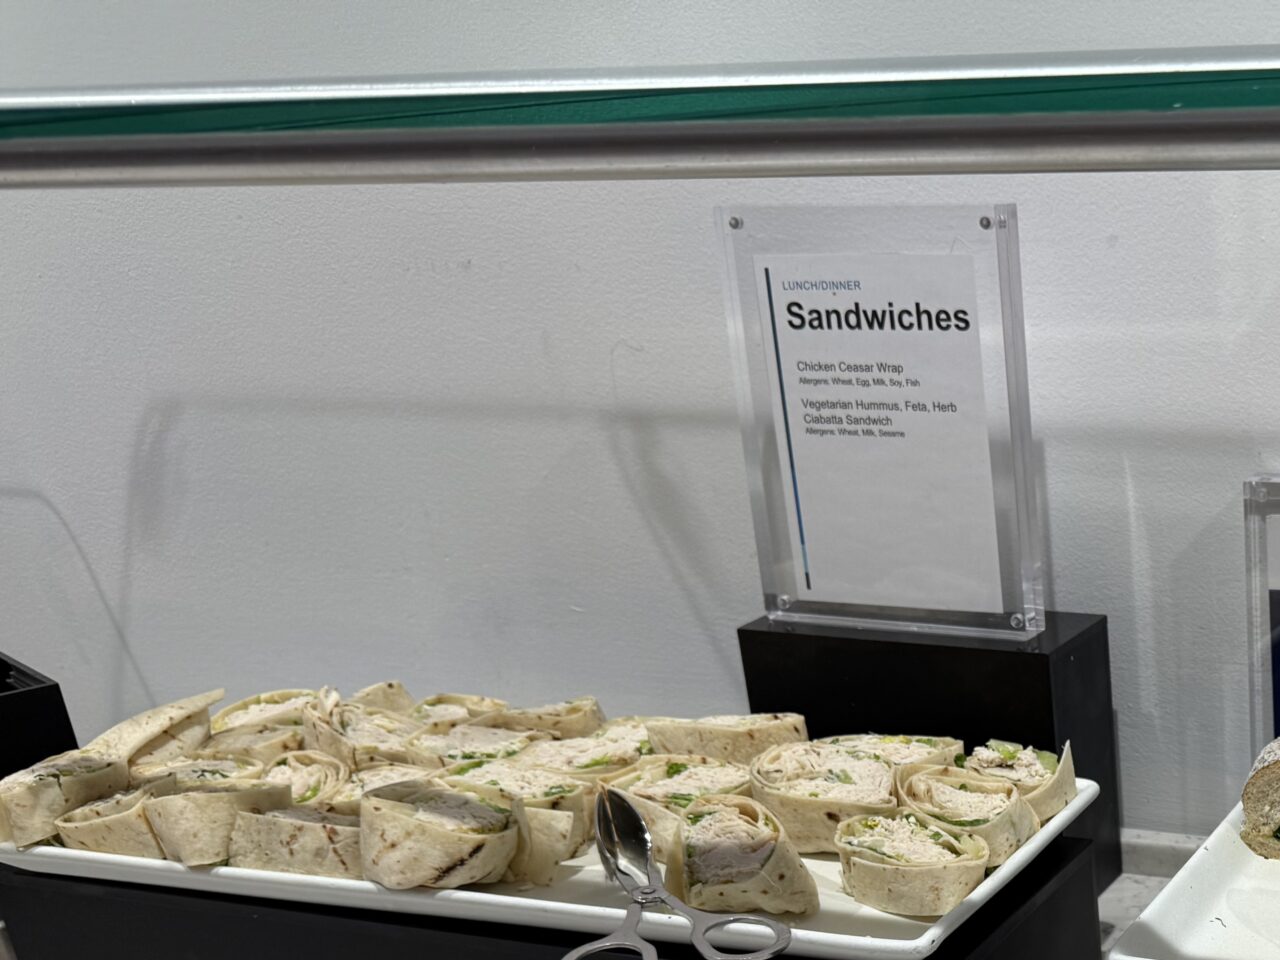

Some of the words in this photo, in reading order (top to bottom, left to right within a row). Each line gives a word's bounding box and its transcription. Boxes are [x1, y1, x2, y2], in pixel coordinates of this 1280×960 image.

[782, 280, 861, 291] LUNCH/DINNER
[786, 301, 970, 332] Sandwiches
[797, 361, 836, 372] Chicken
[839, 361, 874, 373] Ceasar
[876, 362, 904, 375] Wrap
[831, 377, 854, 386] Wheat,
[856, 378, 871, 387] Egg,
[873, 378, 888, 387] Milk,
[889, 379, 904, 388] Soy,
[905, 379, 921, 387] Fish
[801, 399, 853, 411] Vegetarian
[856, 401, 902, 412] Hummus,
[905, 401, 930, 413] Feta,
[932, 402, 958, 413] Herb
[803, 413, 843, 424] Ciabatta
[846, 414, 893, 426] Sandwich
[837, 428, 859, 437] Wheat,
[861, 429, 877, 437] Milk,
[879, 430, 906, 438] Sesame
